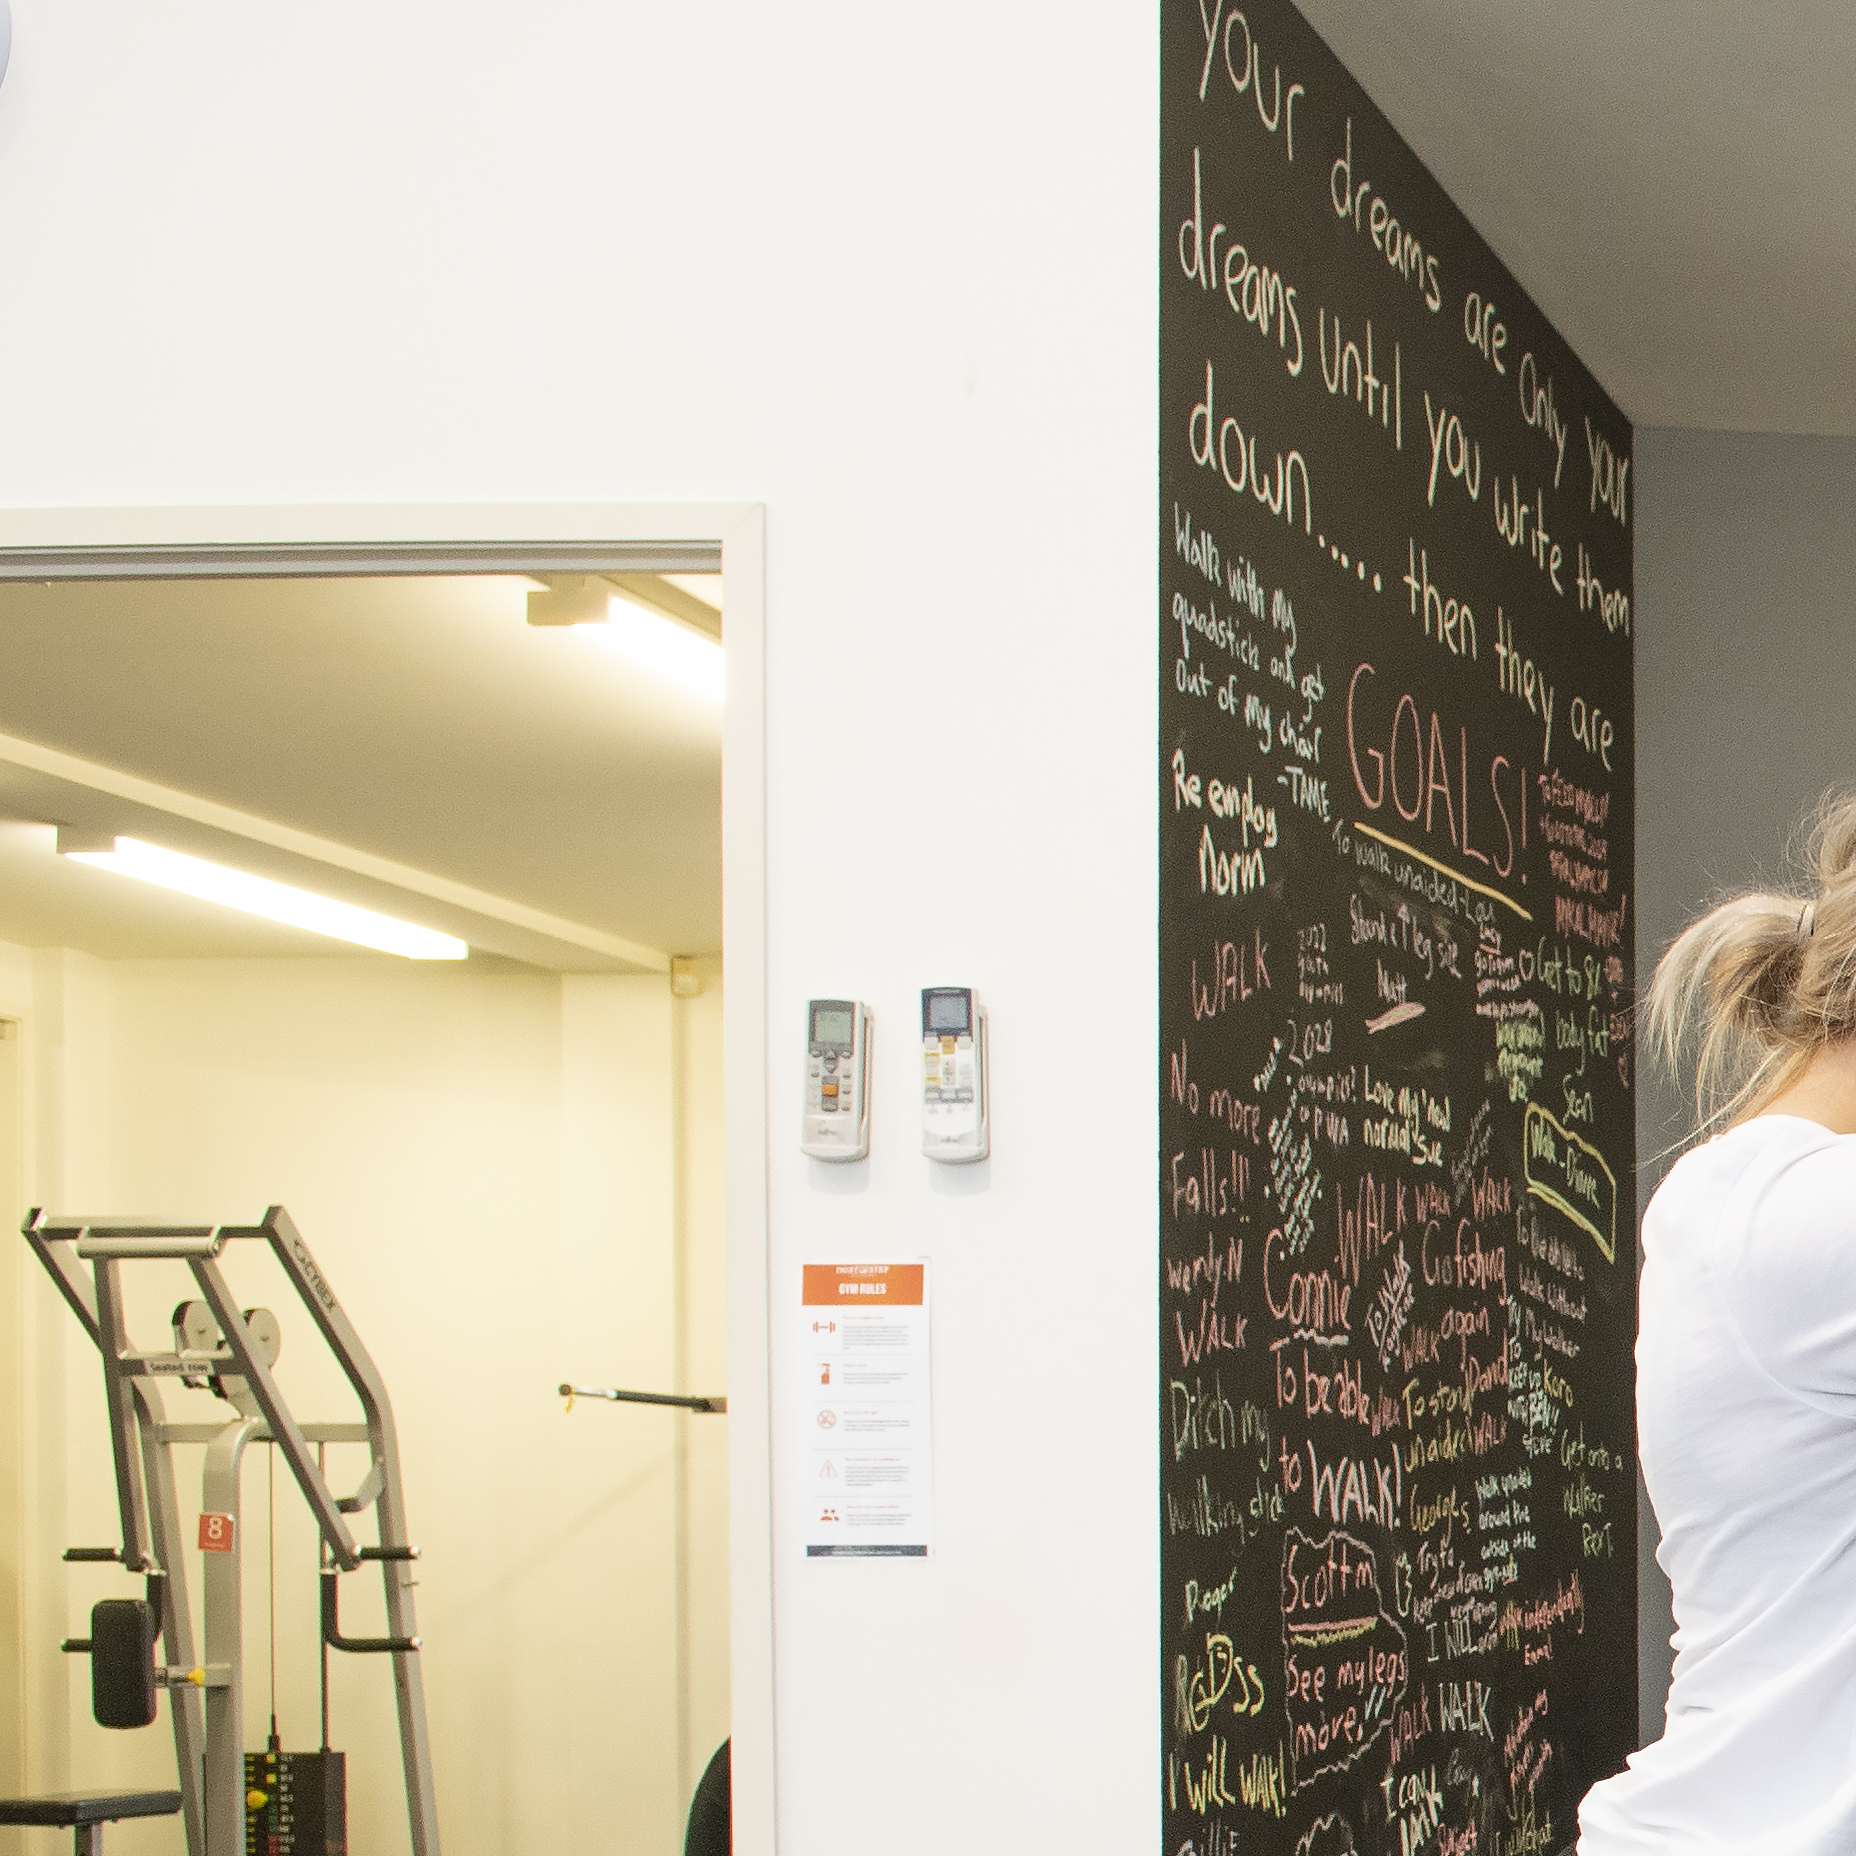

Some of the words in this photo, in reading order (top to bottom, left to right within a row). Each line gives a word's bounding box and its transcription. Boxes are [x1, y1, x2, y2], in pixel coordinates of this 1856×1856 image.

[1199, 0, 1305, 161] your
[1331, 117, 1442, 313] dreams
[1464, 292, 1507, 375] are
[1178, 146, 1303, 376] dreams
[1425, 391, 1480, 506] you
[1403, 537, 1479, 661] then
[1494, 605, 1554, 765] they
[1570, 696, 1615, 773] are
[1346, 661, 1529, 887] GOALS!
[208, 1515, 224, 1540] 8
